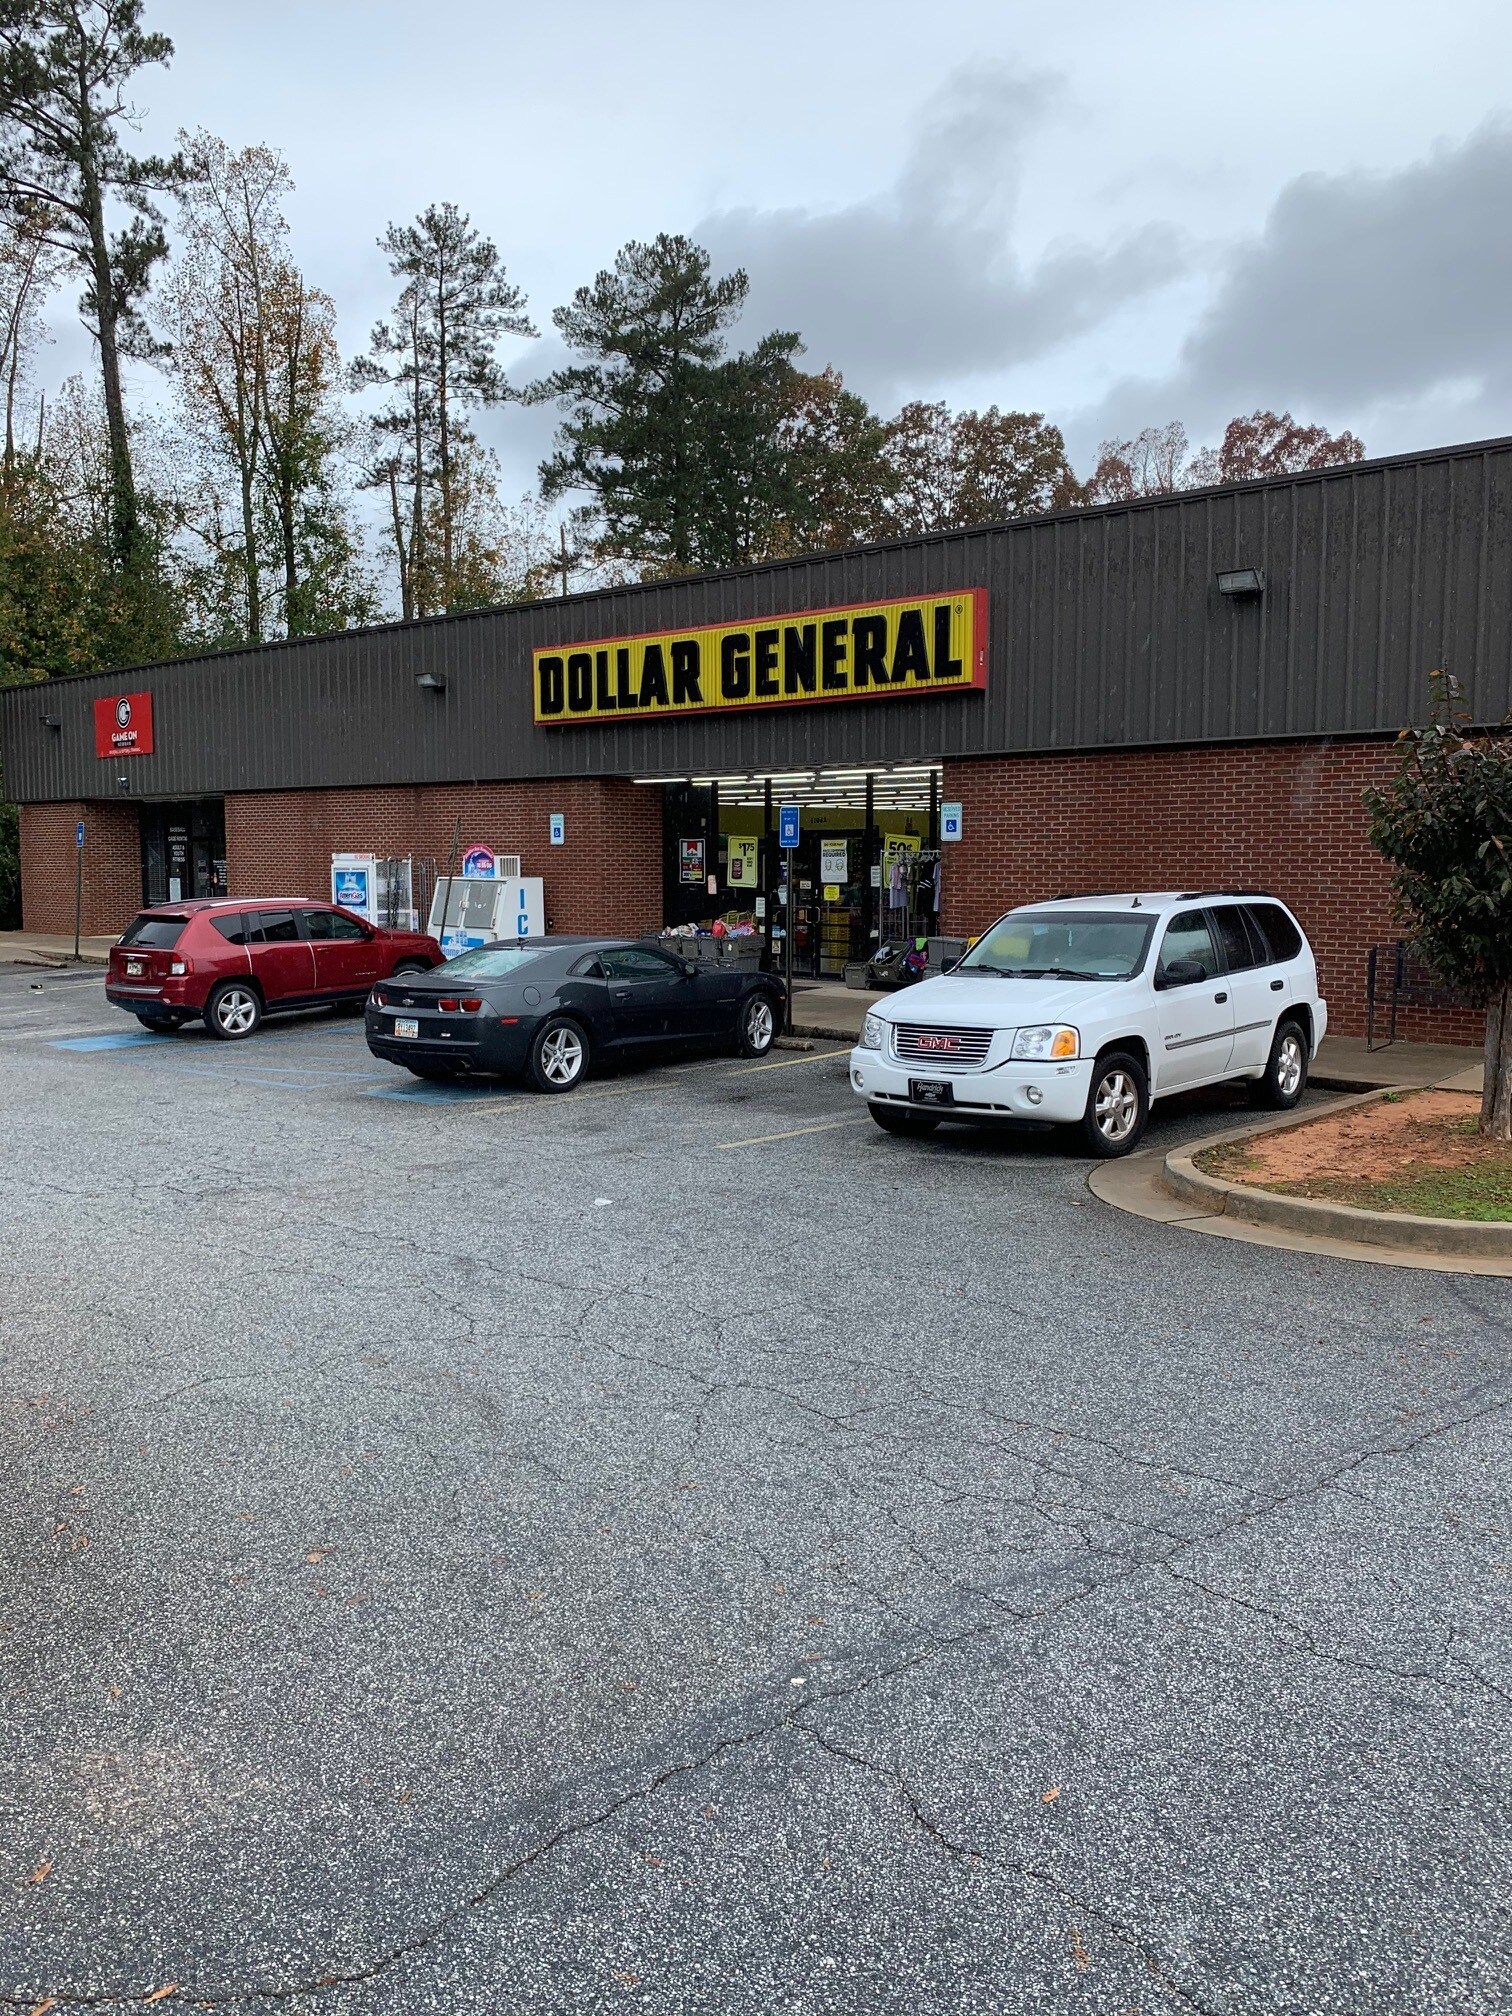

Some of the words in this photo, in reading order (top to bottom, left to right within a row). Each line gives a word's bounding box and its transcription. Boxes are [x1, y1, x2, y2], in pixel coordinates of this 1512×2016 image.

[538, 640, 704, 715] DOLLAR
[721, 604, 963, 699] GENERAL
[111, 732, 127, 742] GAME
[128, 730, 138, 740] ON
[339, 891, 363, 900] AmeriGas
[918, 1036, 961, 1051] GMC
[917, 1081, 943, 1094] Hendrick
